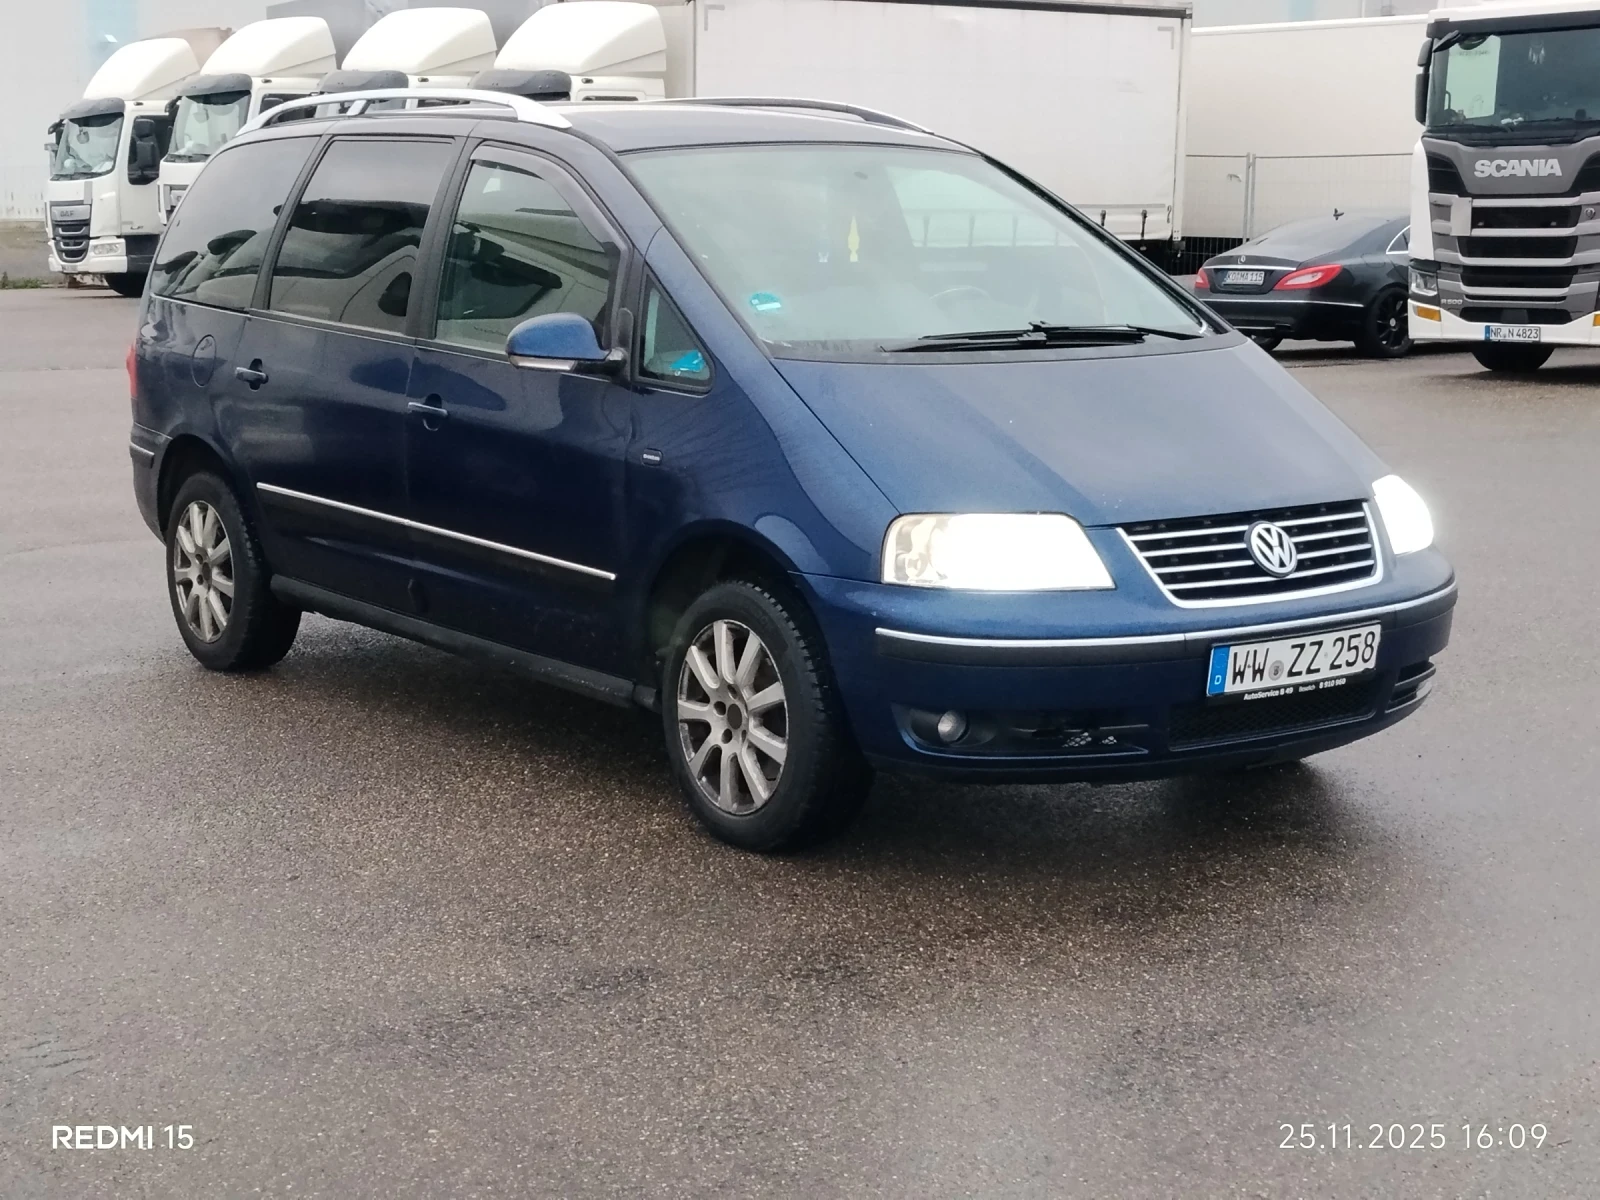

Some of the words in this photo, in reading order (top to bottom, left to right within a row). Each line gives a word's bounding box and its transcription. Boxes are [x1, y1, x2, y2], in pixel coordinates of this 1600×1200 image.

[1474, 158, 1562, 177] SCANIA
[1490, 327, 1502, 338] NR
[1508, 328, 1515, 338] N
[1516, 328, 1539, 339] 4823
[1231, 647, 1270, 686] WW
[1286, 639, 1324, 678] ZZ
[1329, 630, 1376, 671] 258
[1214, 675, 1222, 685] D
[1243, 688, 1279, 701] AutoService
